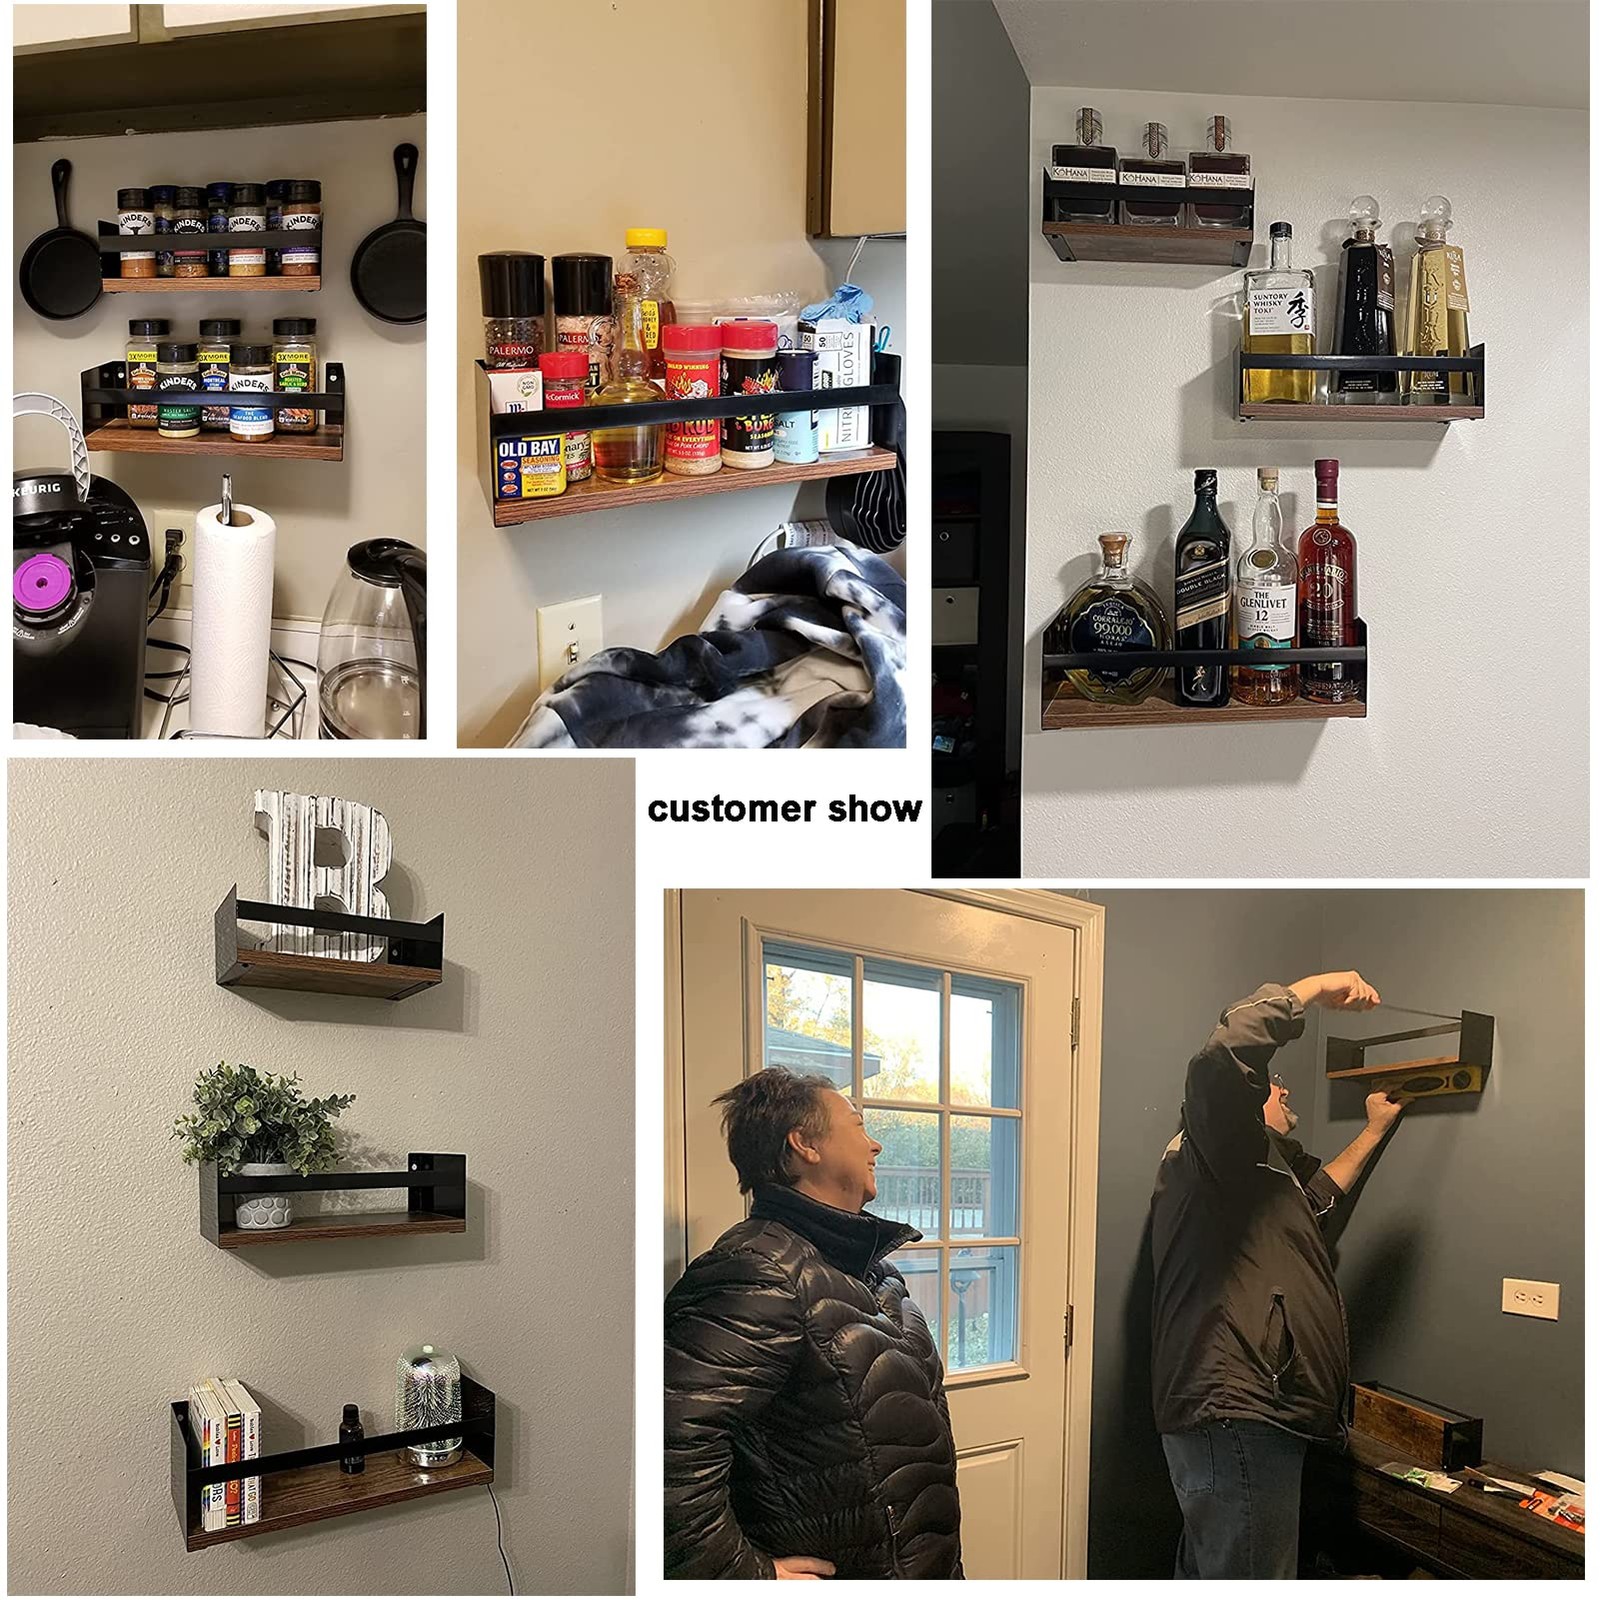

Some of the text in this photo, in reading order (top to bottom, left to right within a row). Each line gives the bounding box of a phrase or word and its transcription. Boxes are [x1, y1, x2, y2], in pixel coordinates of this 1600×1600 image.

[819, 337, 827, 348] 50
[489, 345, 534, 356] PALERMO
[843, 331, 855, 388] GLOVES
[499, 439, 558, 457] OLD BAY
[522, 455, 560, 465] SEASONING
[13, 483, 62, 498] KEURIG
[1176, 573, 1226, 595] DOUBLE BLACK
[1254, 591, 1270, 600] THE
[1240, 596, 1287, 609] GLENLIVET
[1255, 610, 1269, 622] 12
